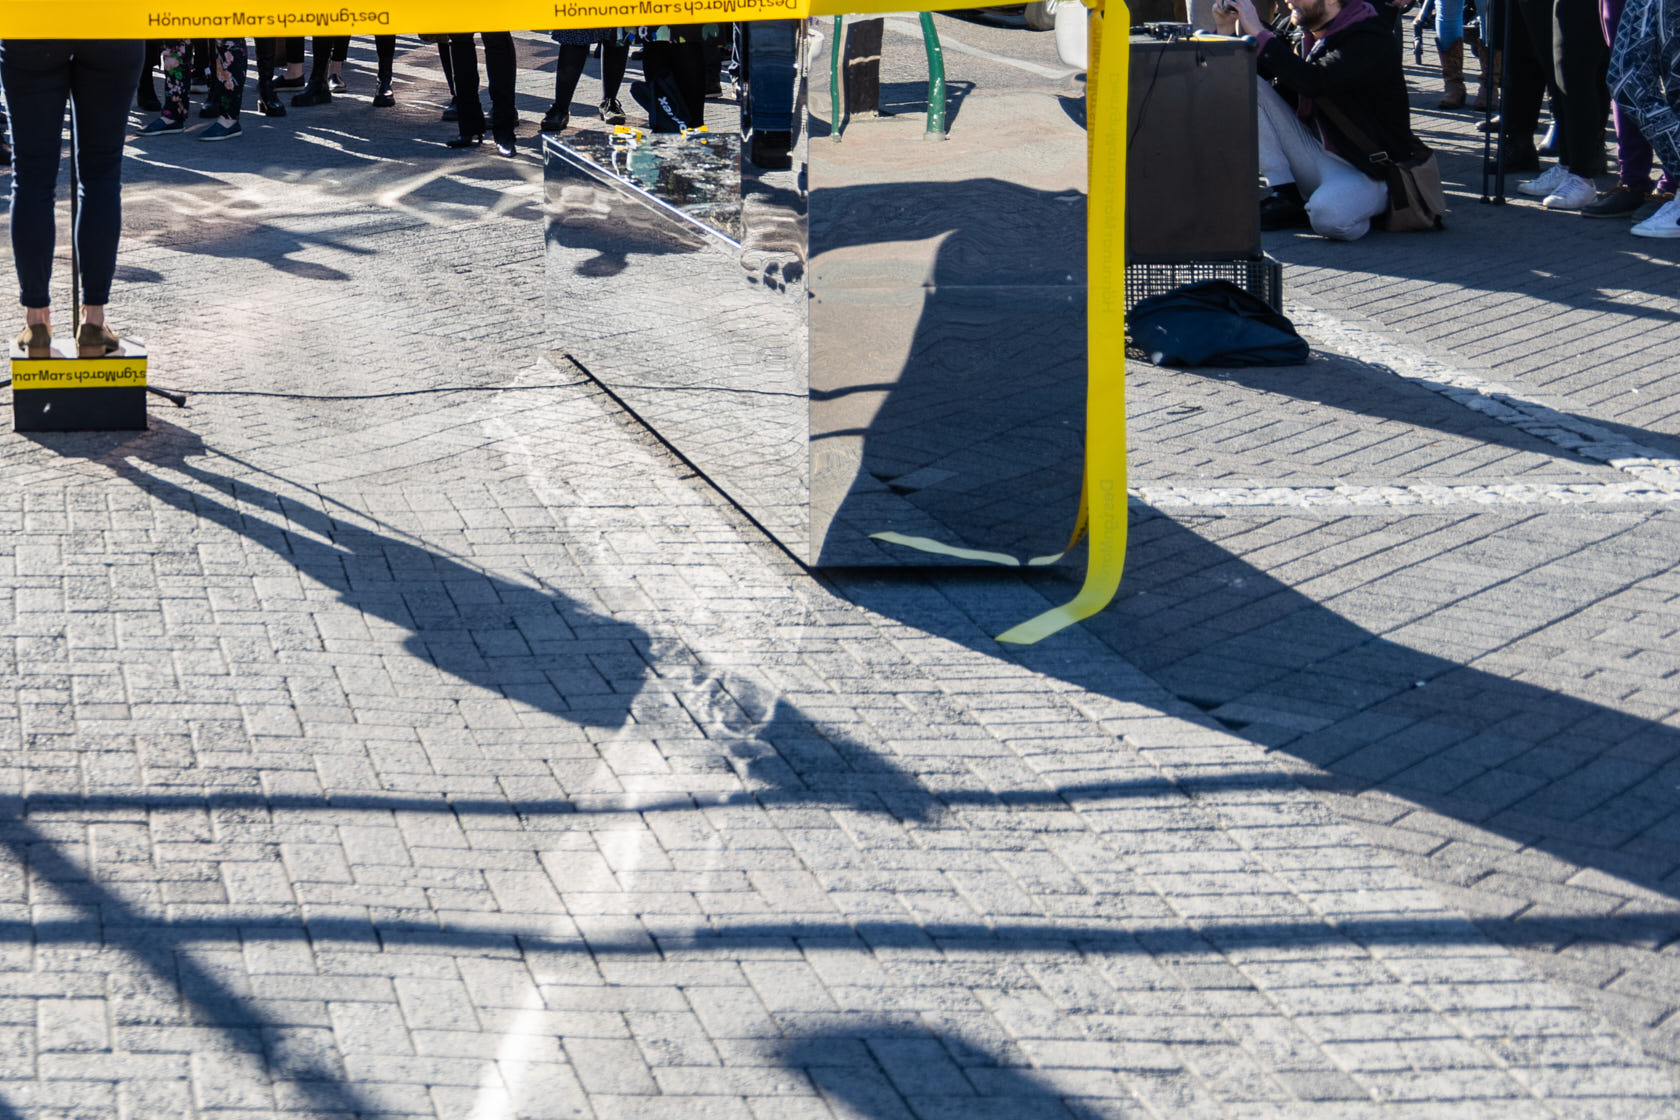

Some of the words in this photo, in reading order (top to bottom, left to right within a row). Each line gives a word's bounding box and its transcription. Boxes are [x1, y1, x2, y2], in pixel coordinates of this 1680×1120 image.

[554, 1, 682, 17] HönnunarMars
[148, 12, 275, 27] HönnunarMars
[277, 8, 390, 28] DesignMarch
[74, 366, 146, 383] signMarch
